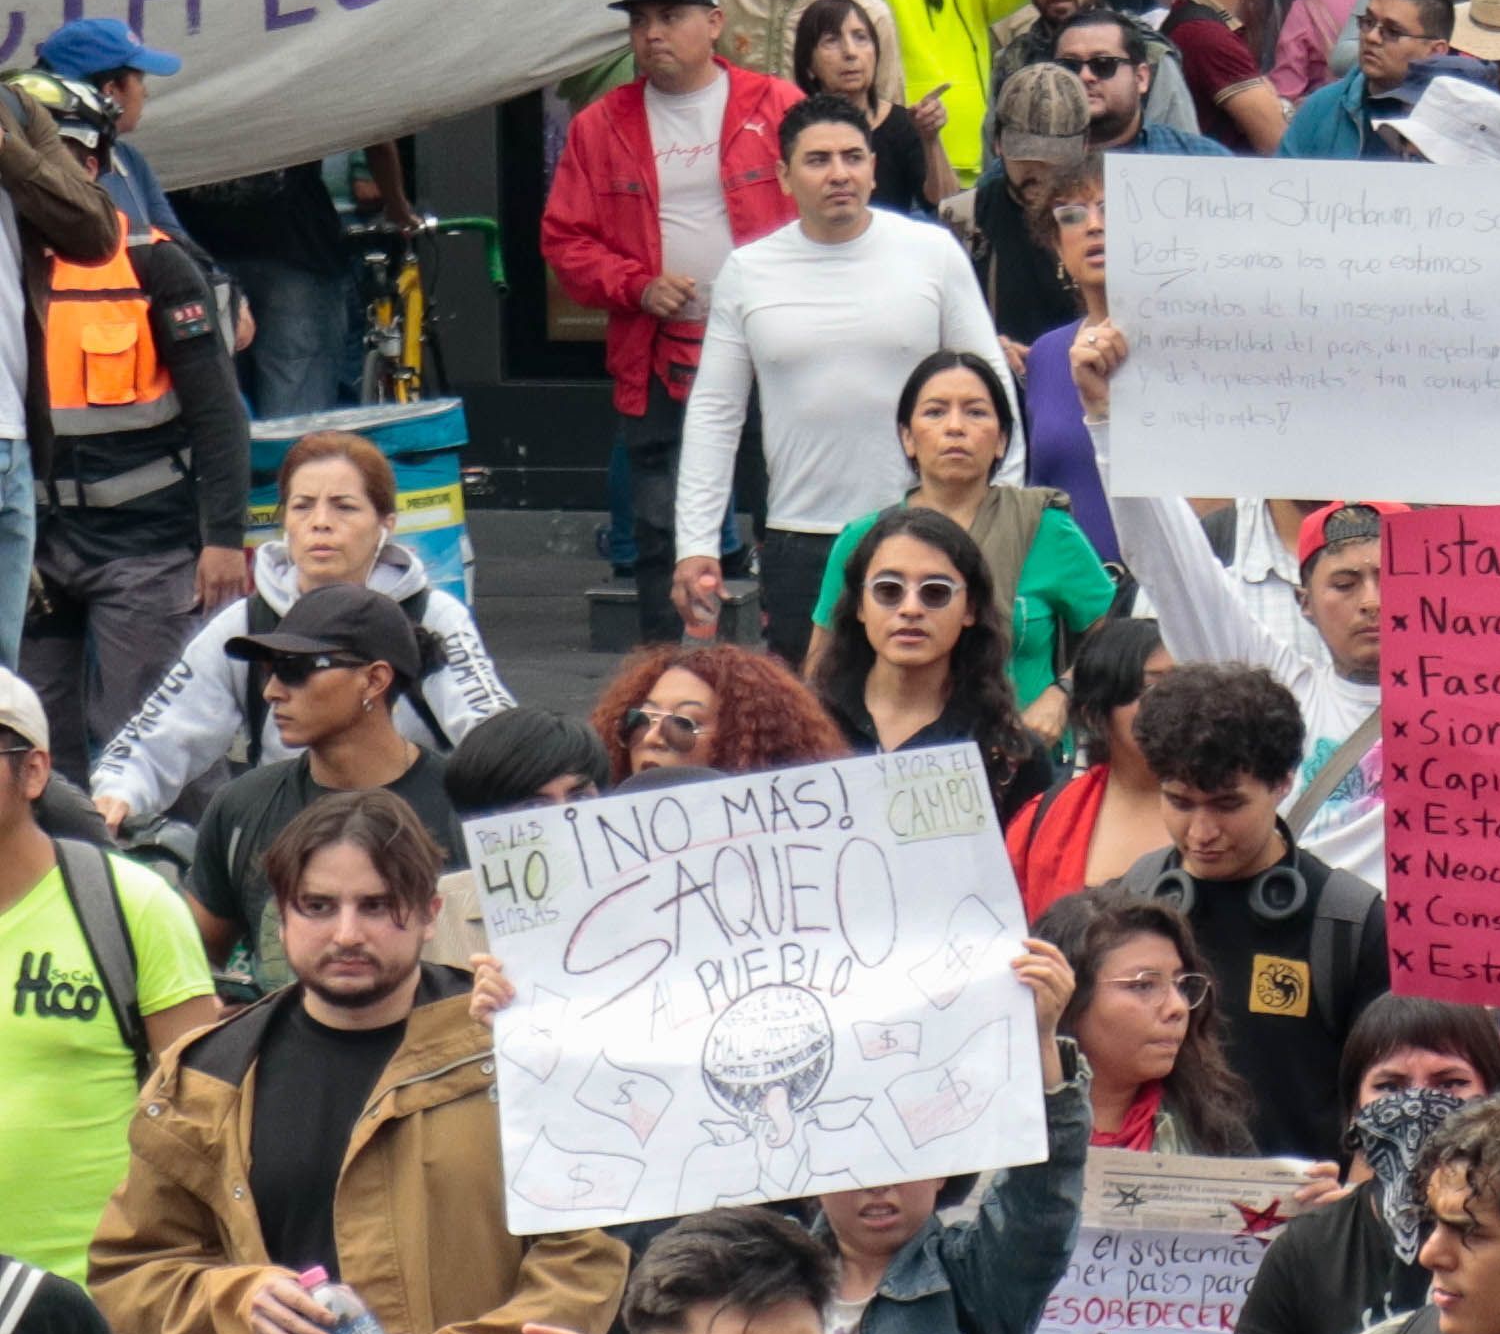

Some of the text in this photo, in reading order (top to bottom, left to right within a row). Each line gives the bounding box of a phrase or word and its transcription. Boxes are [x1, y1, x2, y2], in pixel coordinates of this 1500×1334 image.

[897, 750, 981, 780] POR EL
[721, 767, 855, 837] MÁS!
[888, 776, 986, 837] CAMPO!
[480, 849, 551, 907] 40
[490, 902, 560, 936] HORAS
[563, 836, 899, 1019] SAQUEO
[695, 941, 855, 1014] PUEBLO
